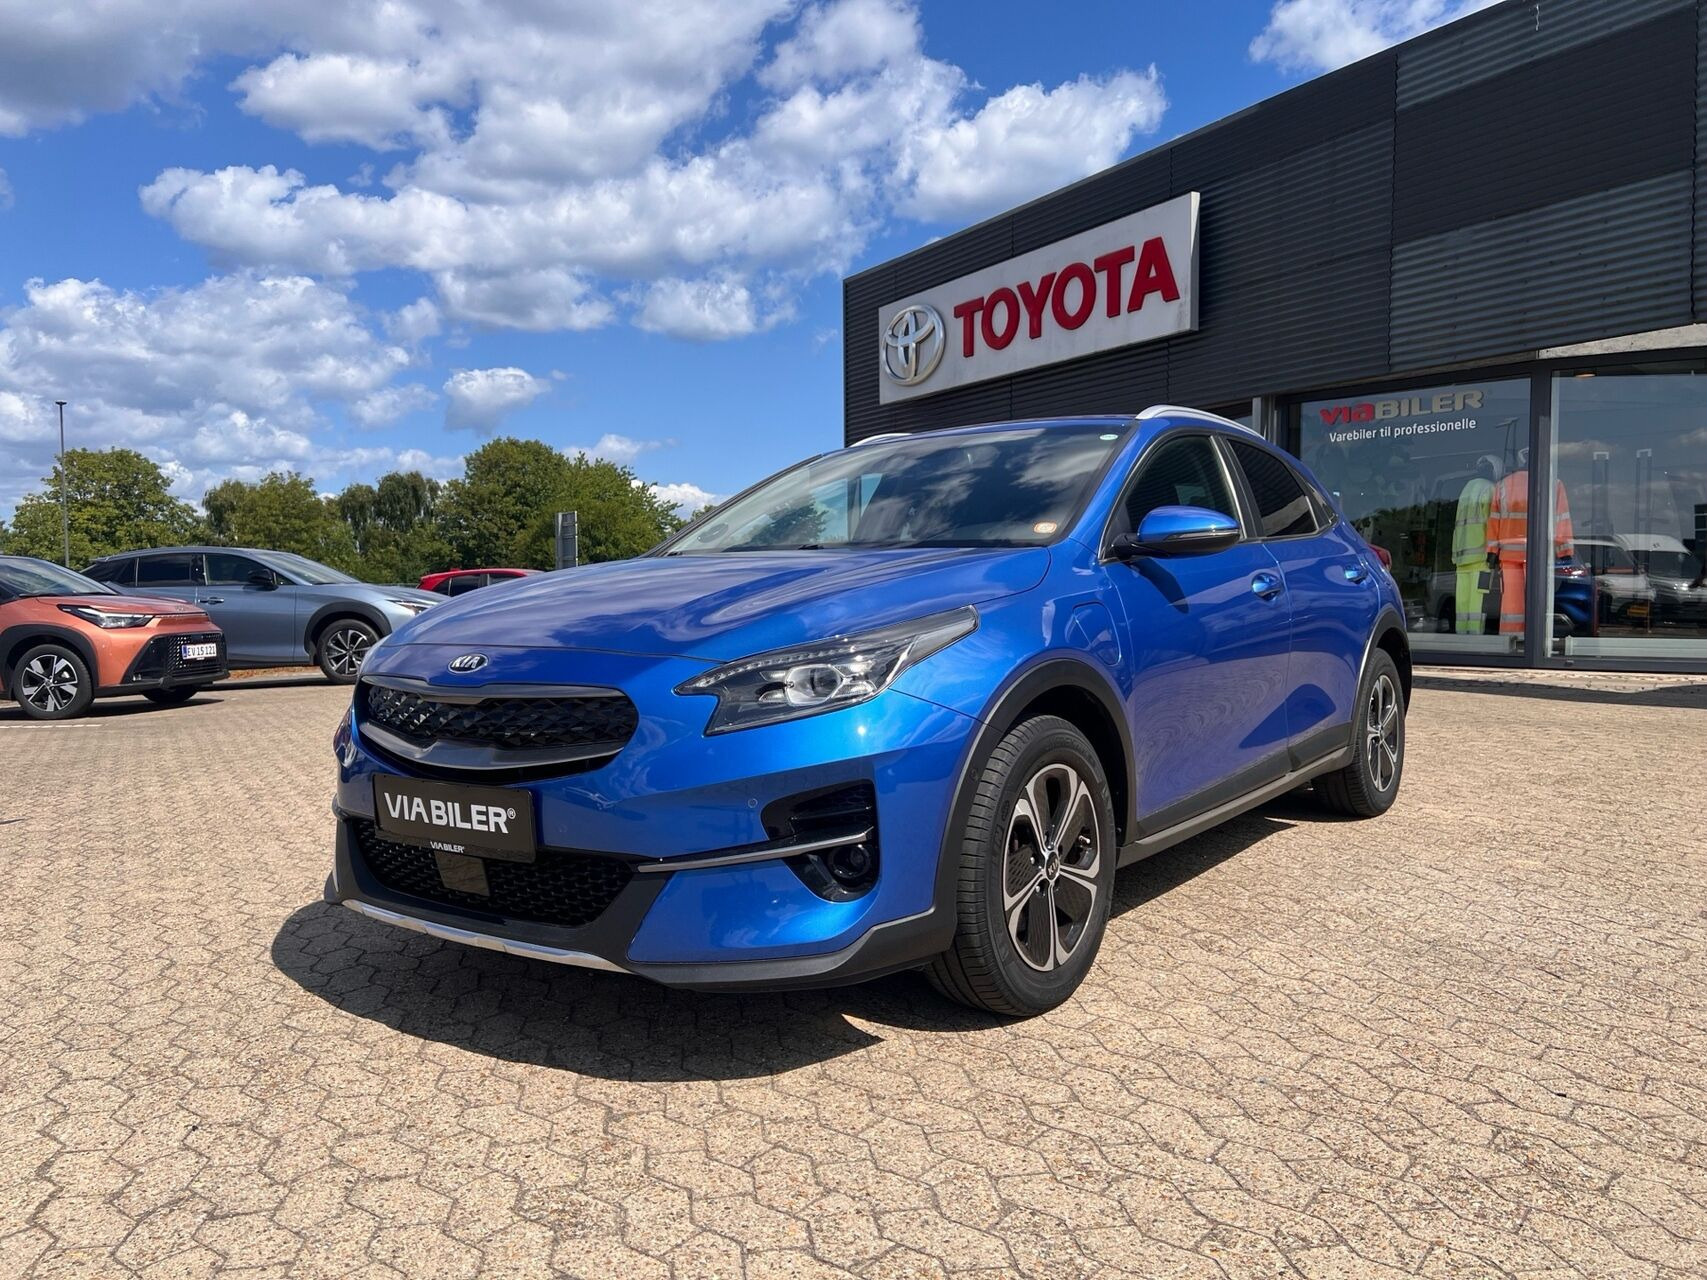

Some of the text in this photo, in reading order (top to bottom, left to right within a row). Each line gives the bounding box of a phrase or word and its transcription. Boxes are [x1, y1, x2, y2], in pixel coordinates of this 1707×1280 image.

[954, 236, 1180, 358] TOYOTA
[1329, 418, 1477, 443] Varebiler til professionelle
[451, 655, 480, 668] KIA
